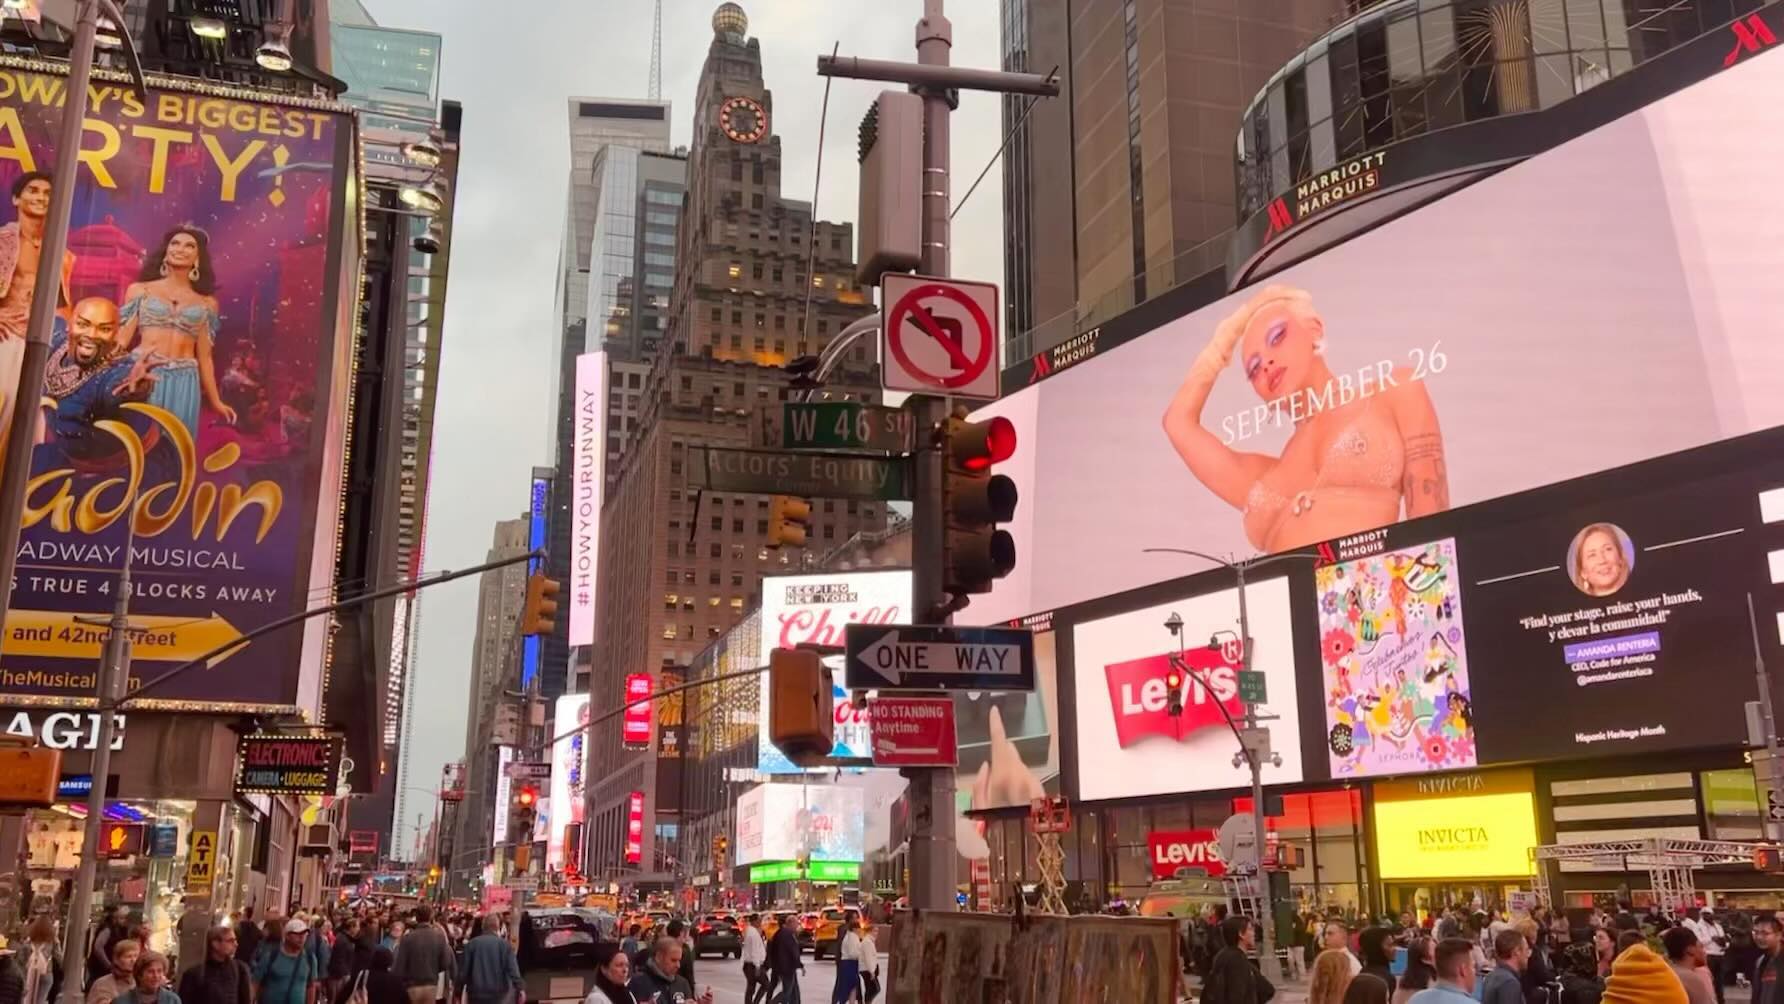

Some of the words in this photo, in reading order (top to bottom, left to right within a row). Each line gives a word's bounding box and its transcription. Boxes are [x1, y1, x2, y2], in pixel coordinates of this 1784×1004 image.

[157, 95, 331, 141] BIGGEST
[1298, 151, 1386, 199] MARRIOTT
[1299, 173, 1376, 217] MARQUIS
[1053, 327, 1100, 357] MARRIOTT
[1054, 343, 1095, 369] MARQUIS
[1222, 359, 1399, 446] SEPTEMBER
[1408, 340, 1448, 382] 26
[791, 409, 818, 441] W
[833, 408, 871, 442] 46
[708, 450, 797, 478] Actors'
[811, 456, 890, 489] Equity
[577, 389, 596, 607] #HOWYOURUNWAY
[1339, 528, 1389, 549] MARRIOTT
[129, 547, 246, 570] MUSICAL
[1340, 541, 1384, 560] MARQUIS
[30, 576, 89, 594] TRUE
[98, 581, 111, 595] 4
[216, 586, 277, 603] AWAY
[786, 584, 849, 595] KEEPING
[786, 593, 815, 605] NEW
[821, 592, 858, 603] YORK
[1549, 611, 1573, 628] your
[1574, 605, 1606, 622] stage,
[1606, 602, 1634, 616] raise
[1635, 595, 1661, 613] your
[1662, 588, 1703, 607] hands,
[13, 626, 53, 642] and
[124, 630, 177, 648] treet
[1549, 631, 1556, 643] y
[1557, 624, 1589, 641] elevar
[1590, 622, 1601, 635] la
[877, 645, 929, 670] ONE
[955, 646, 1009, 671] WAY
[1577, 643, 1616, 658] AMANDA
[1616, 637, 1657, 652] RENTERIA
[1610, 656, 1623, 667] for
[1623, 652, 1656, 665] America
[873, 705, 888, 718] NO
[891, 704, 944, 719] STANDING
[875, 721, 920, 736] Anytime
[1575, 730, 1607, 744] Hispanic
[1606, 729, 1640, 740] Heritage
[1640, 724, 1666, 737] Month
[246, 770, 280, 786] CAMERA
[284, 772, 325, 787] LUGGAGE
[1418, 775, 1485, 793] INVICTA
[1418, 827, 1489, 845] INVICTA
[191, 834, 212, 876] ATM
